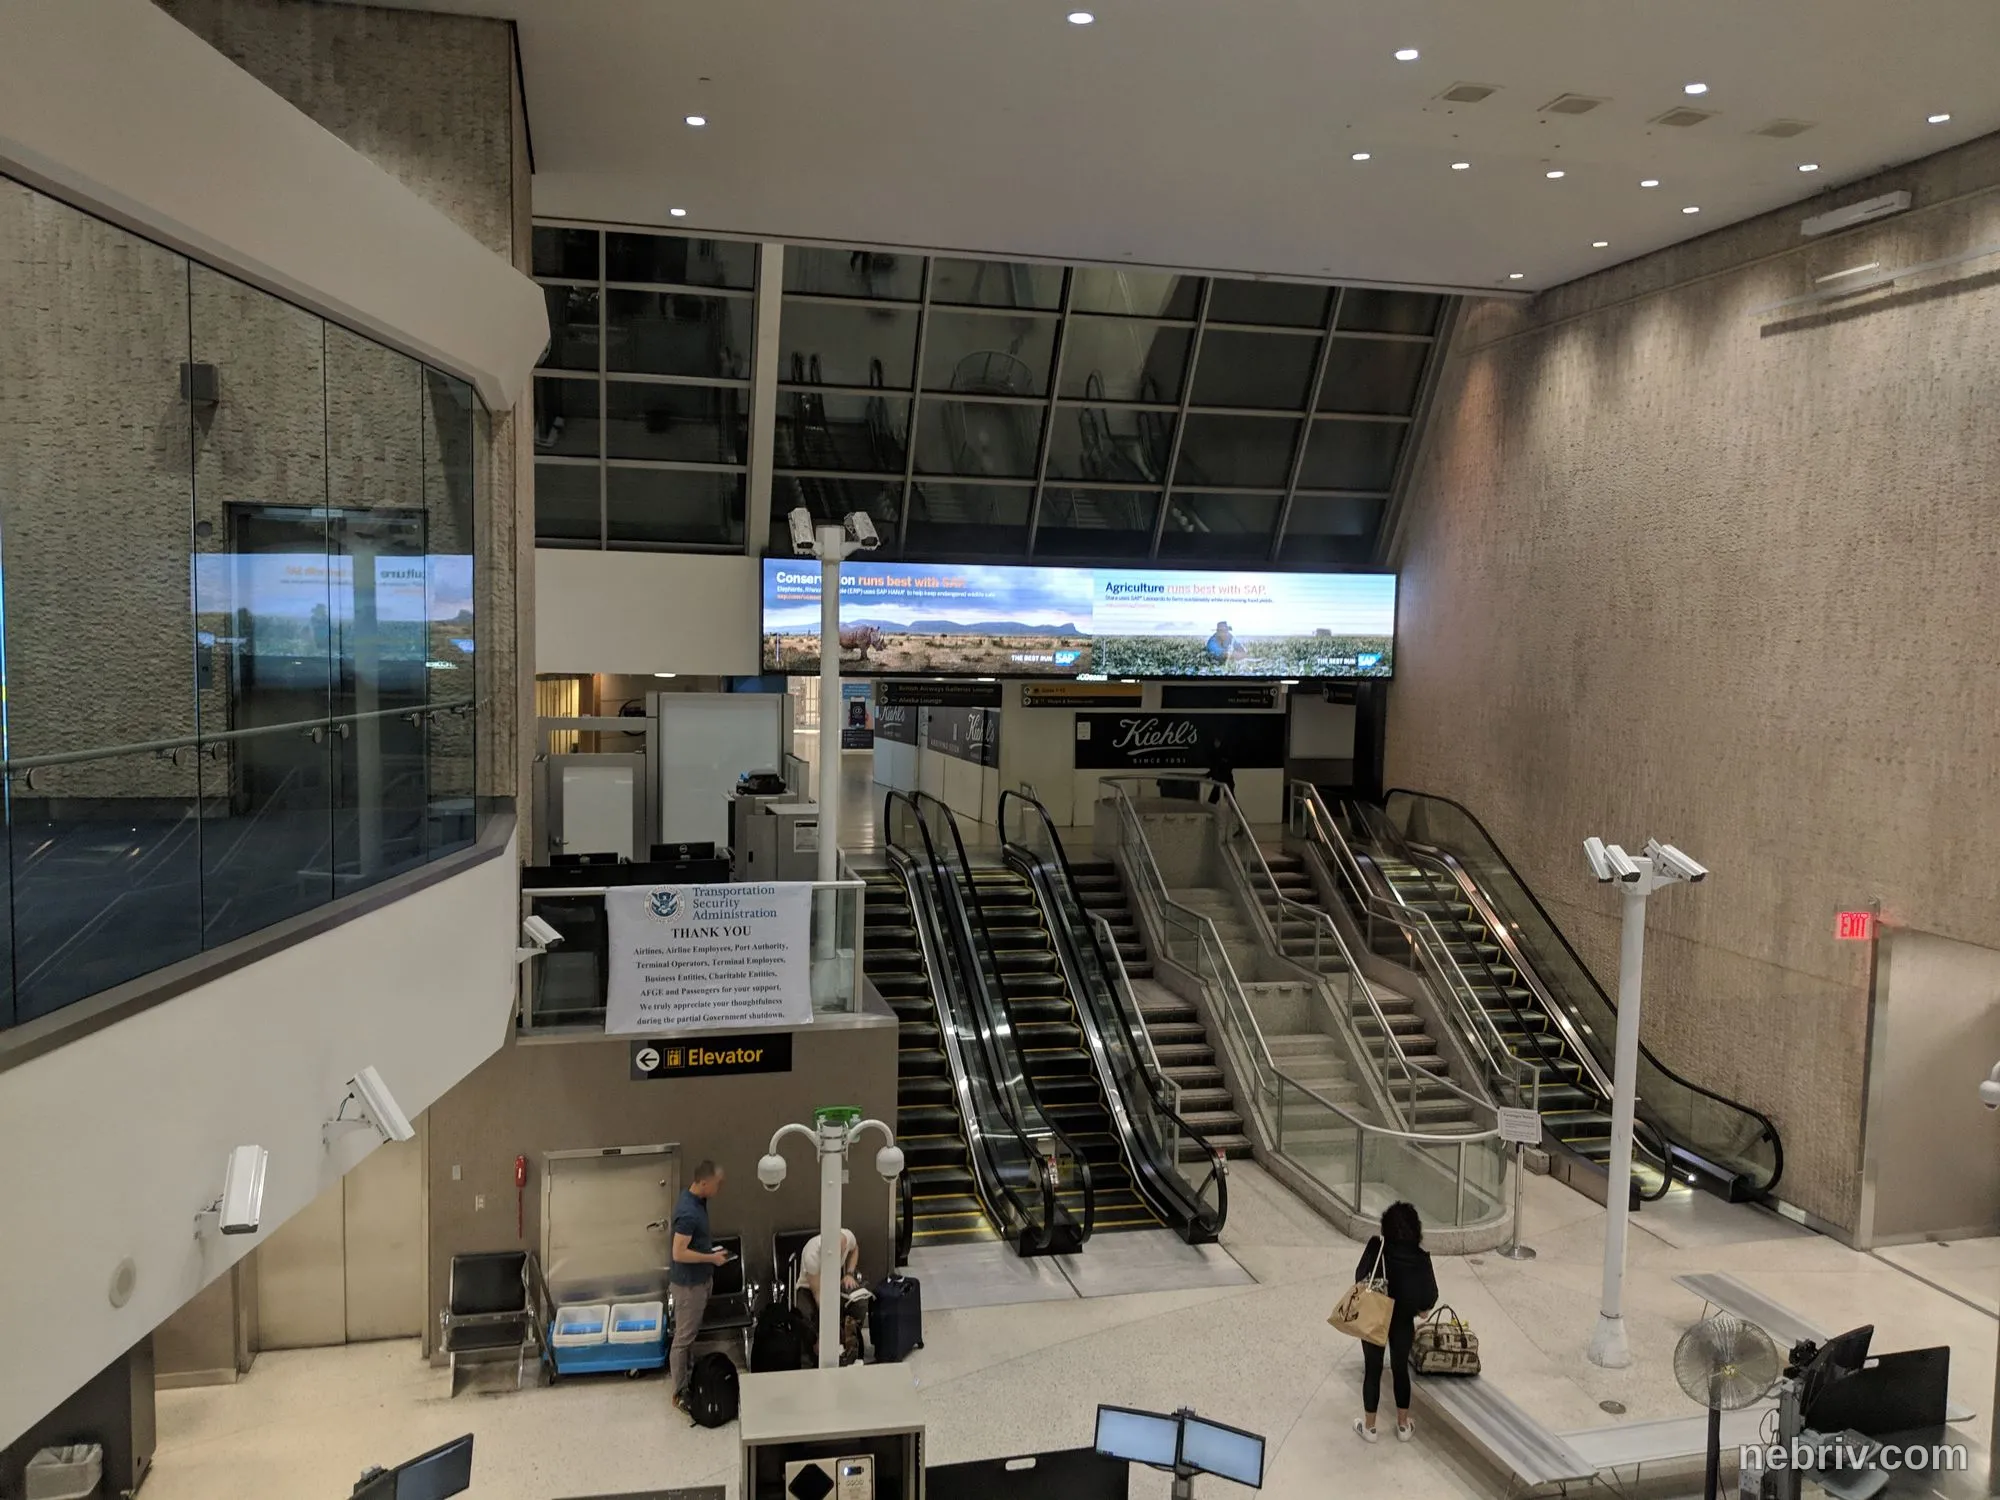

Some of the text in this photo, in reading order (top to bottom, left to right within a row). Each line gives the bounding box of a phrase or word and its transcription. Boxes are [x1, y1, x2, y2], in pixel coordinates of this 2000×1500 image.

[776, 571, 856, 586] Conseron
[858, 575, 884, 587] runs
[886, 575, 912, 588] best
[914, 576, 940, 588] with
[1105, 581, 1165, 595] Agriculture
[1167, 584, 1191, 594] runs
[1193, 584, 1216, 594] best
[1218, 584, 1241, 595] with
[1011, 654, 1024, 662] THE
[1055, 652, 1076, 664] SAP
[1358, 654, 1377, 666] SAP
[1112, 717, 1199, 748] Kiehl's
[1132, 757, 1161, 765] SINCE
[692, 885, 776, 899] Transportation
[692, 898, 741, 910] Security
[692, 907, 778, 921] Administration
[671, 925, 752, 939] THANK YOU
[1840, 912, 1869, 938] EXIT
[634, 942, 789, 956] Airlines, Airline Employees, Port Authority,
[636, 956, 786, 969] Terminal Operators, Terminal Employees,
[645, 974, 676, 983] Business
[677, 973, 707, 982] Entities,
[708, 971, 747, 981] Charitable
[640, 988, 664, 997] AFGE
[665, 987, 680, 996] and
[681, 987, 720, 996] Passengers
[721, 985, 733, 993] for
[733, 986, 750, 994] your
[639, 998, 783, 1012] We truly appreciate your thoughtfulness
[636, 1017, 662, 1026] during
[663, 1016, 675, 1024] the
[676, 1014, 701, 1025] partial
[702, 1013, 748, 1023] Government
[687, 1047, 764, 1067] Elevator
